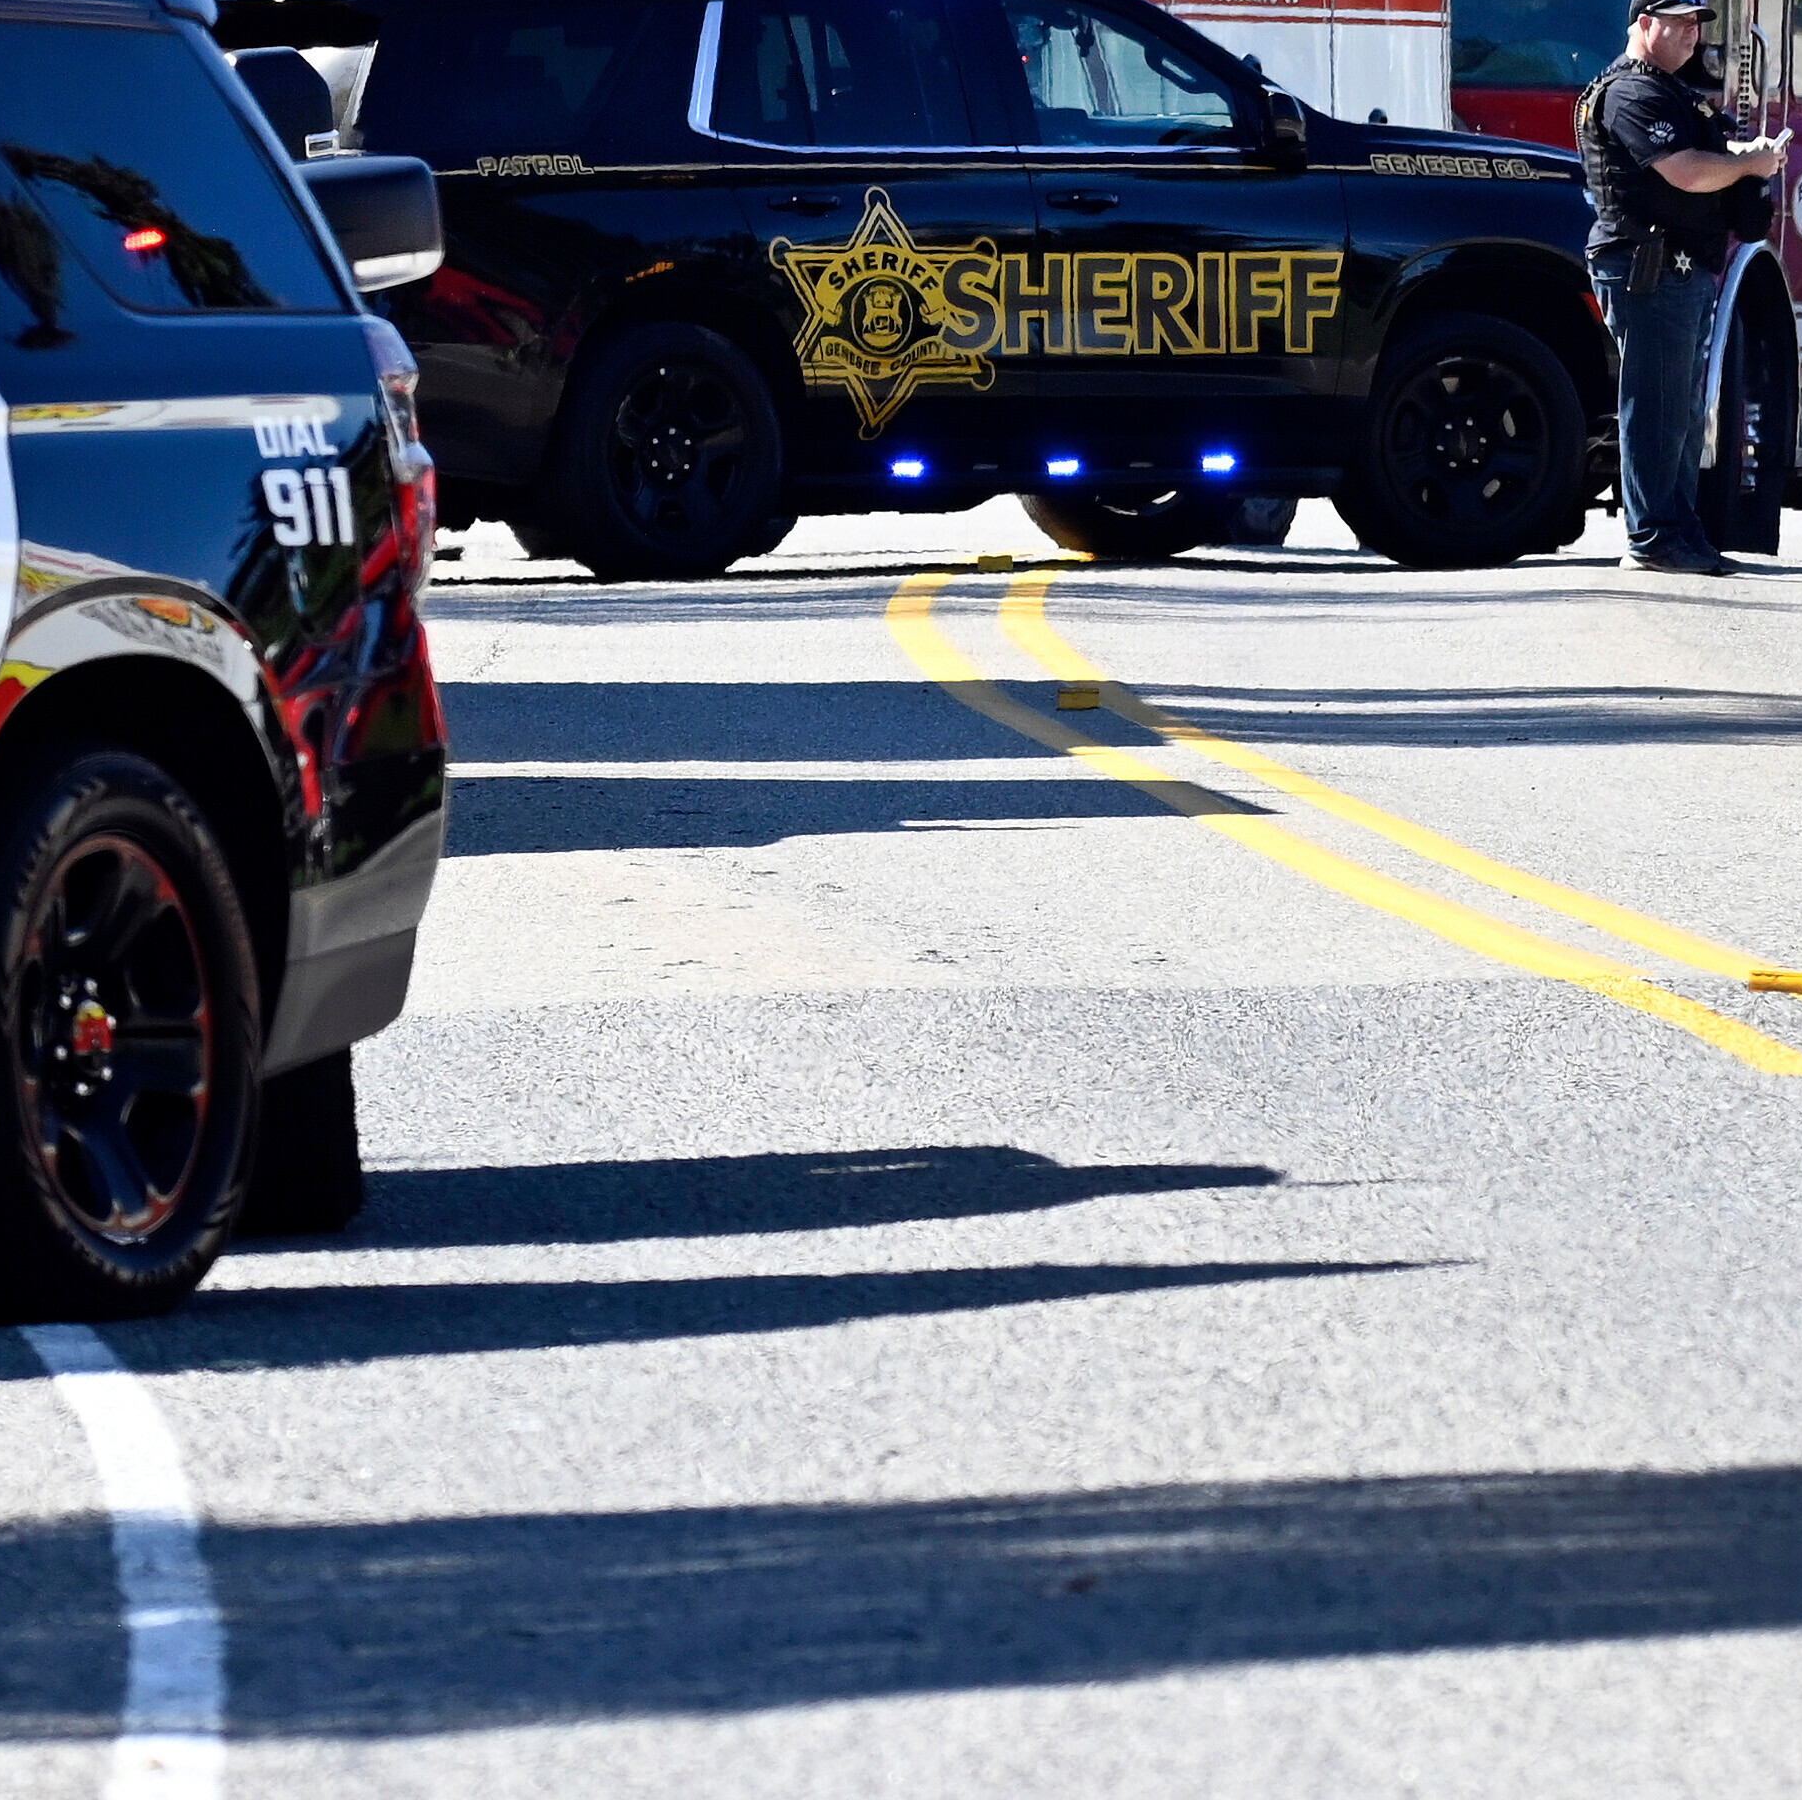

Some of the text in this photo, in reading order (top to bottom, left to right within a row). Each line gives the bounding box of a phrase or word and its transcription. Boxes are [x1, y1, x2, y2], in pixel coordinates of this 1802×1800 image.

[477, 154, 595, 177] PATROL
[1370, 153, 1540, 180] GENESEE CO.
[828, 251, 940, 292] SHERIFF
[940, 251, 1345, 355] SHERIFF
[824, 339, 943, 376] GENESEE COUNTY
[253, 415, 339, 459] DIAL
[261, 467, 355, 547] 911
